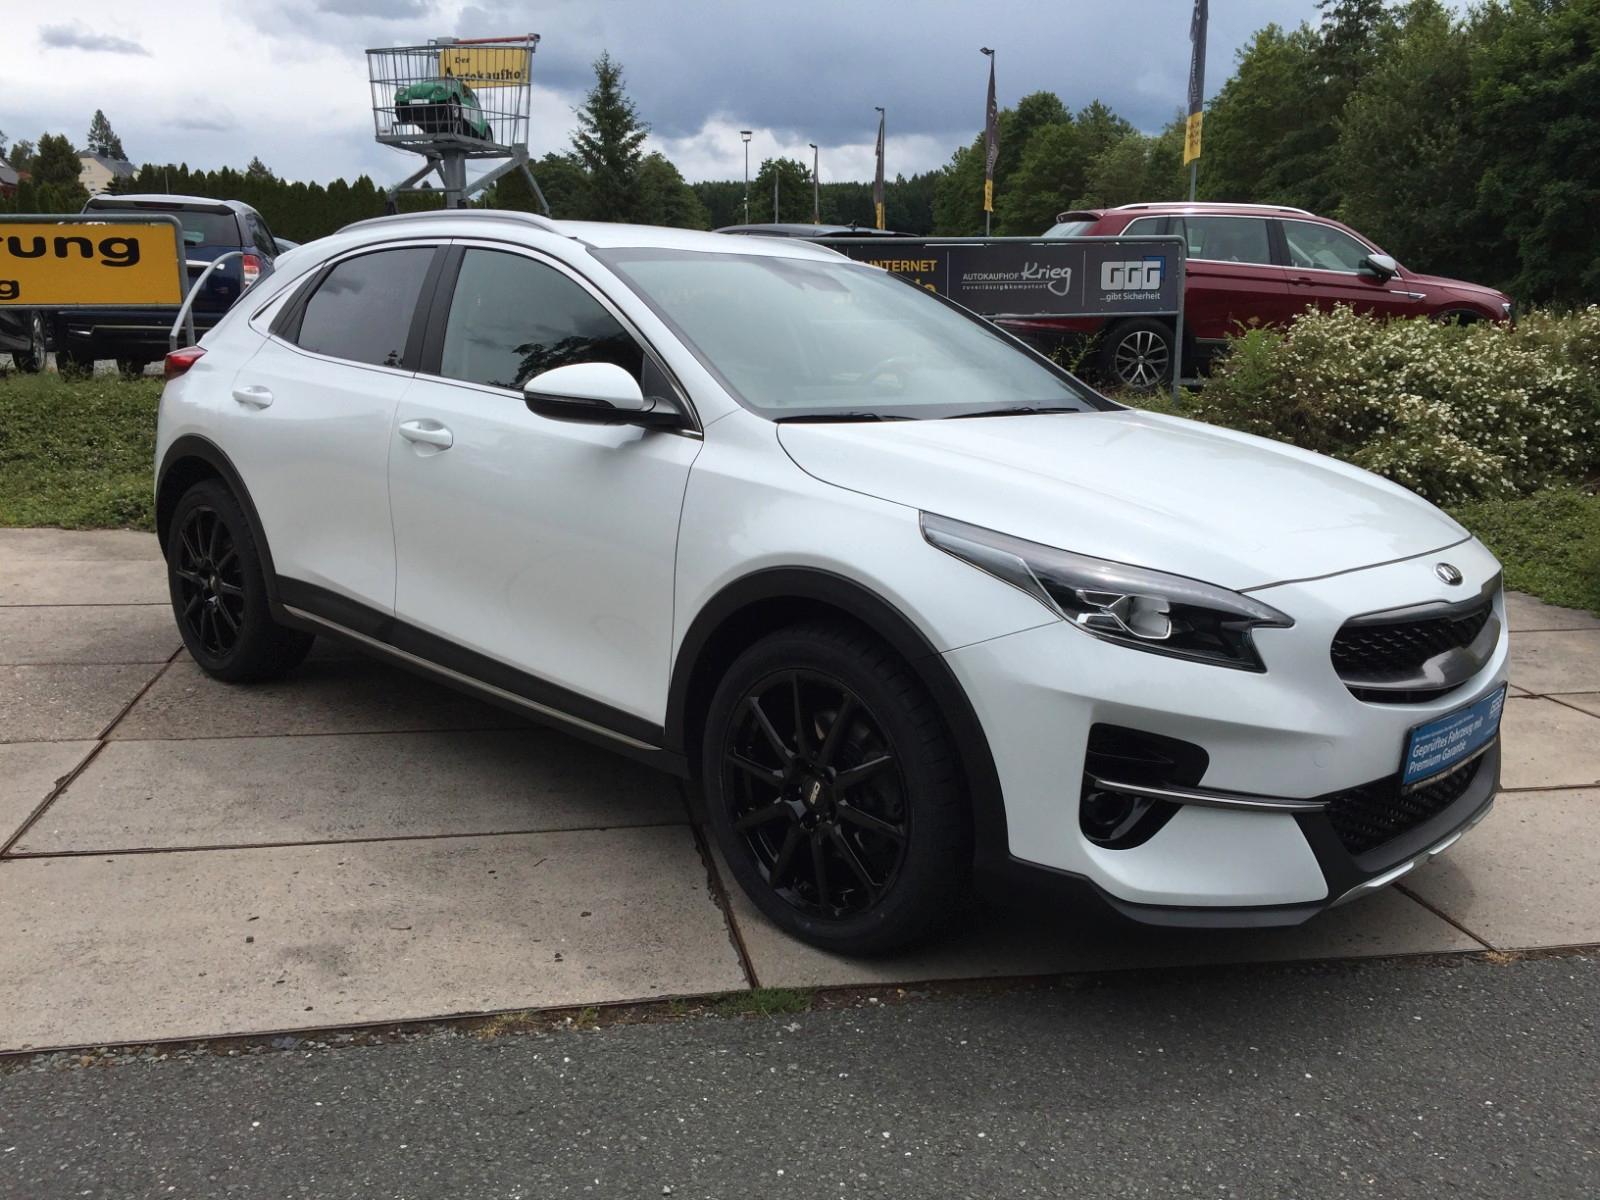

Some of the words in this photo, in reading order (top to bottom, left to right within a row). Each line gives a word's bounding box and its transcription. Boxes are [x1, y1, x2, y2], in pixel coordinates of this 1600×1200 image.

[0, 236, 140, 267] ung
[962, 273, 1019, 281] AUTOKAUFHOF
[1020, 262, 1072, 296] Krieg
[1123, 291, 1161, 301] Sicherheit
[1408, 755, 1441, 775] Premium
